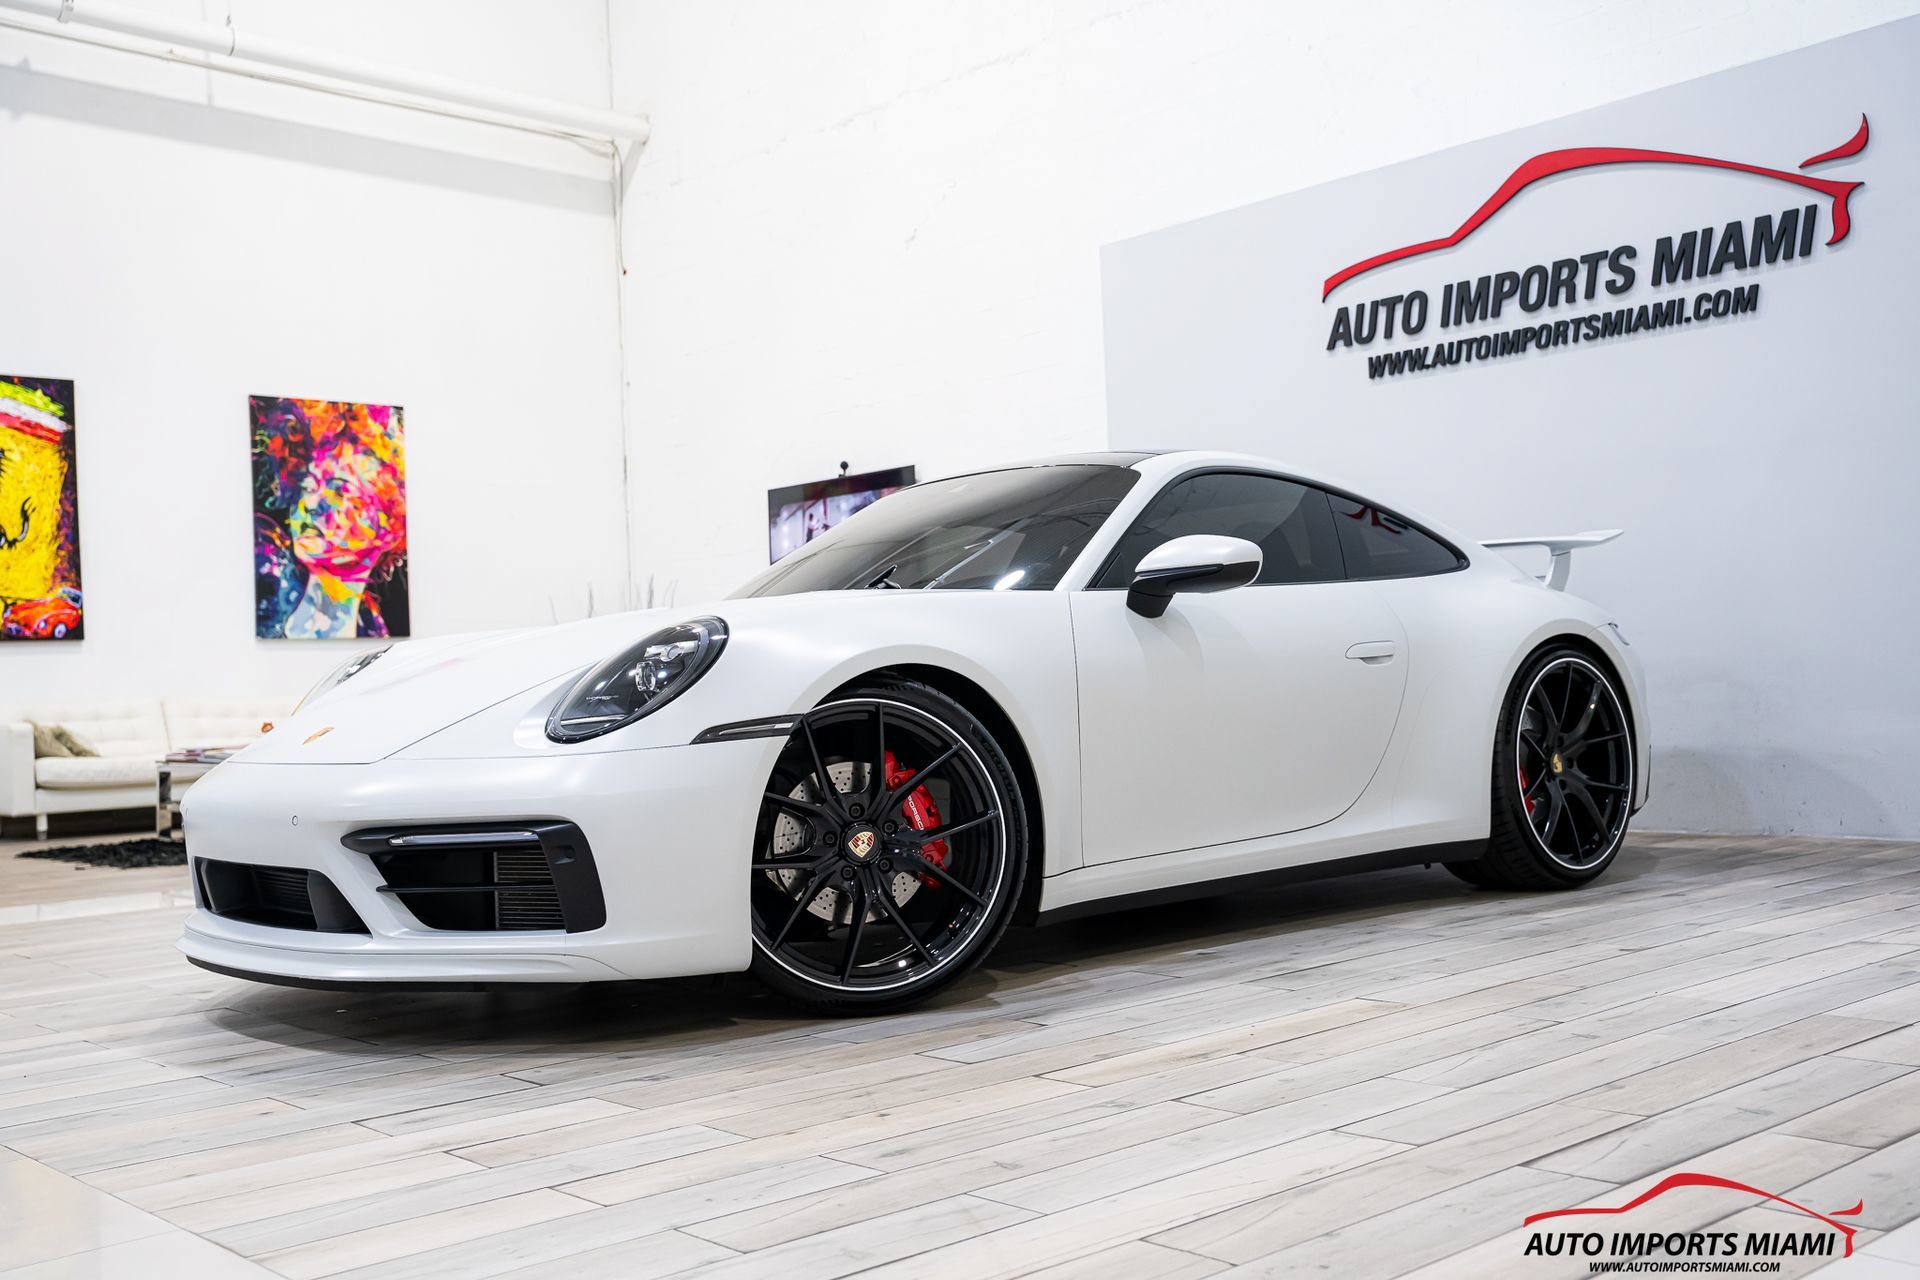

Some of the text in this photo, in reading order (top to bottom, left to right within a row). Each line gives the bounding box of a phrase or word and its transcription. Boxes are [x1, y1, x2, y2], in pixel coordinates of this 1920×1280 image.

[1327, 204, 1818, 350] AUTO IMPORTS MIAMI
[1369, 284, 1760, 380] WWW.AUTOIMPORTSMIAMI.COM
